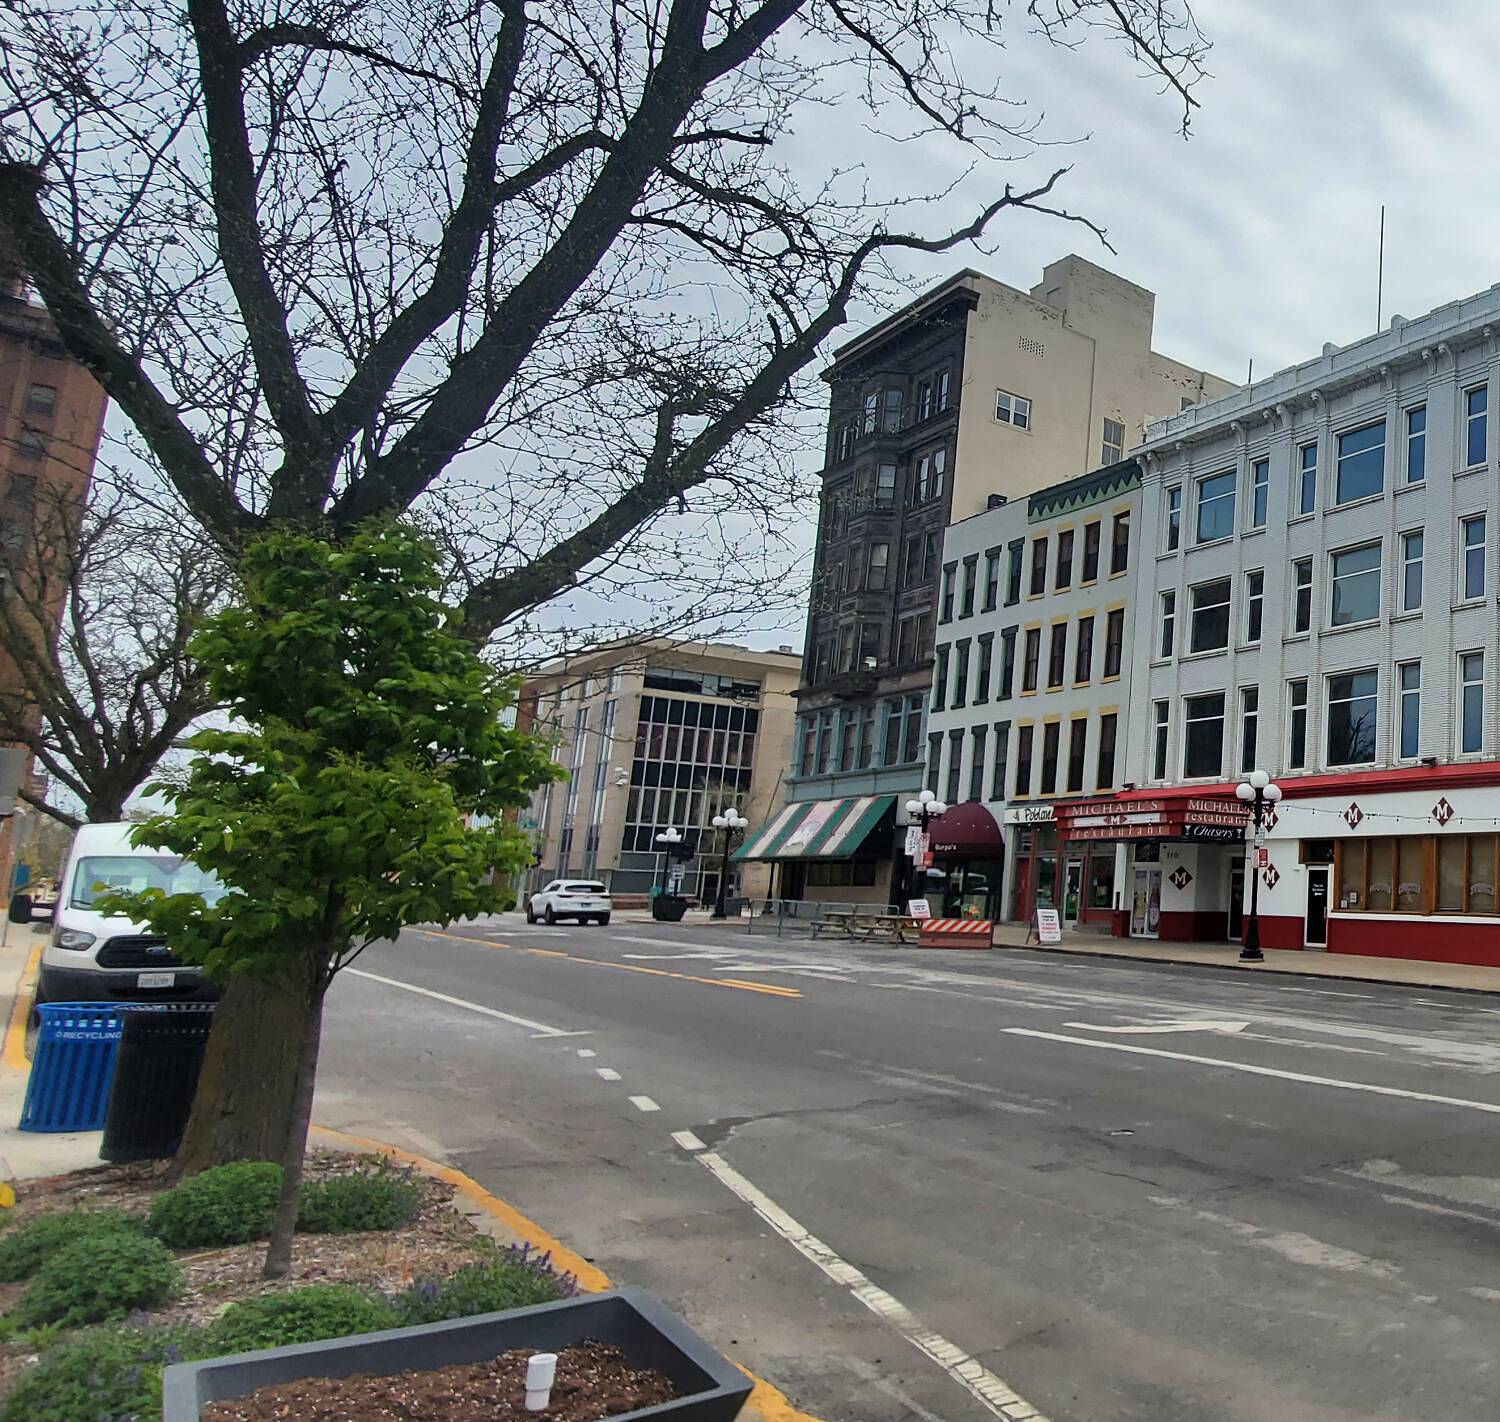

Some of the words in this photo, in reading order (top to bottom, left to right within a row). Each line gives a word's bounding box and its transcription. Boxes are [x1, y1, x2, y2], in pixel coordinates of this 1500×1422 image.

[1071, 800, 1159, 816] MICHAEL'S
[1193, 825, 1234, 838] Chasers
[63, 1031, 122, 1039] RECYCLING
